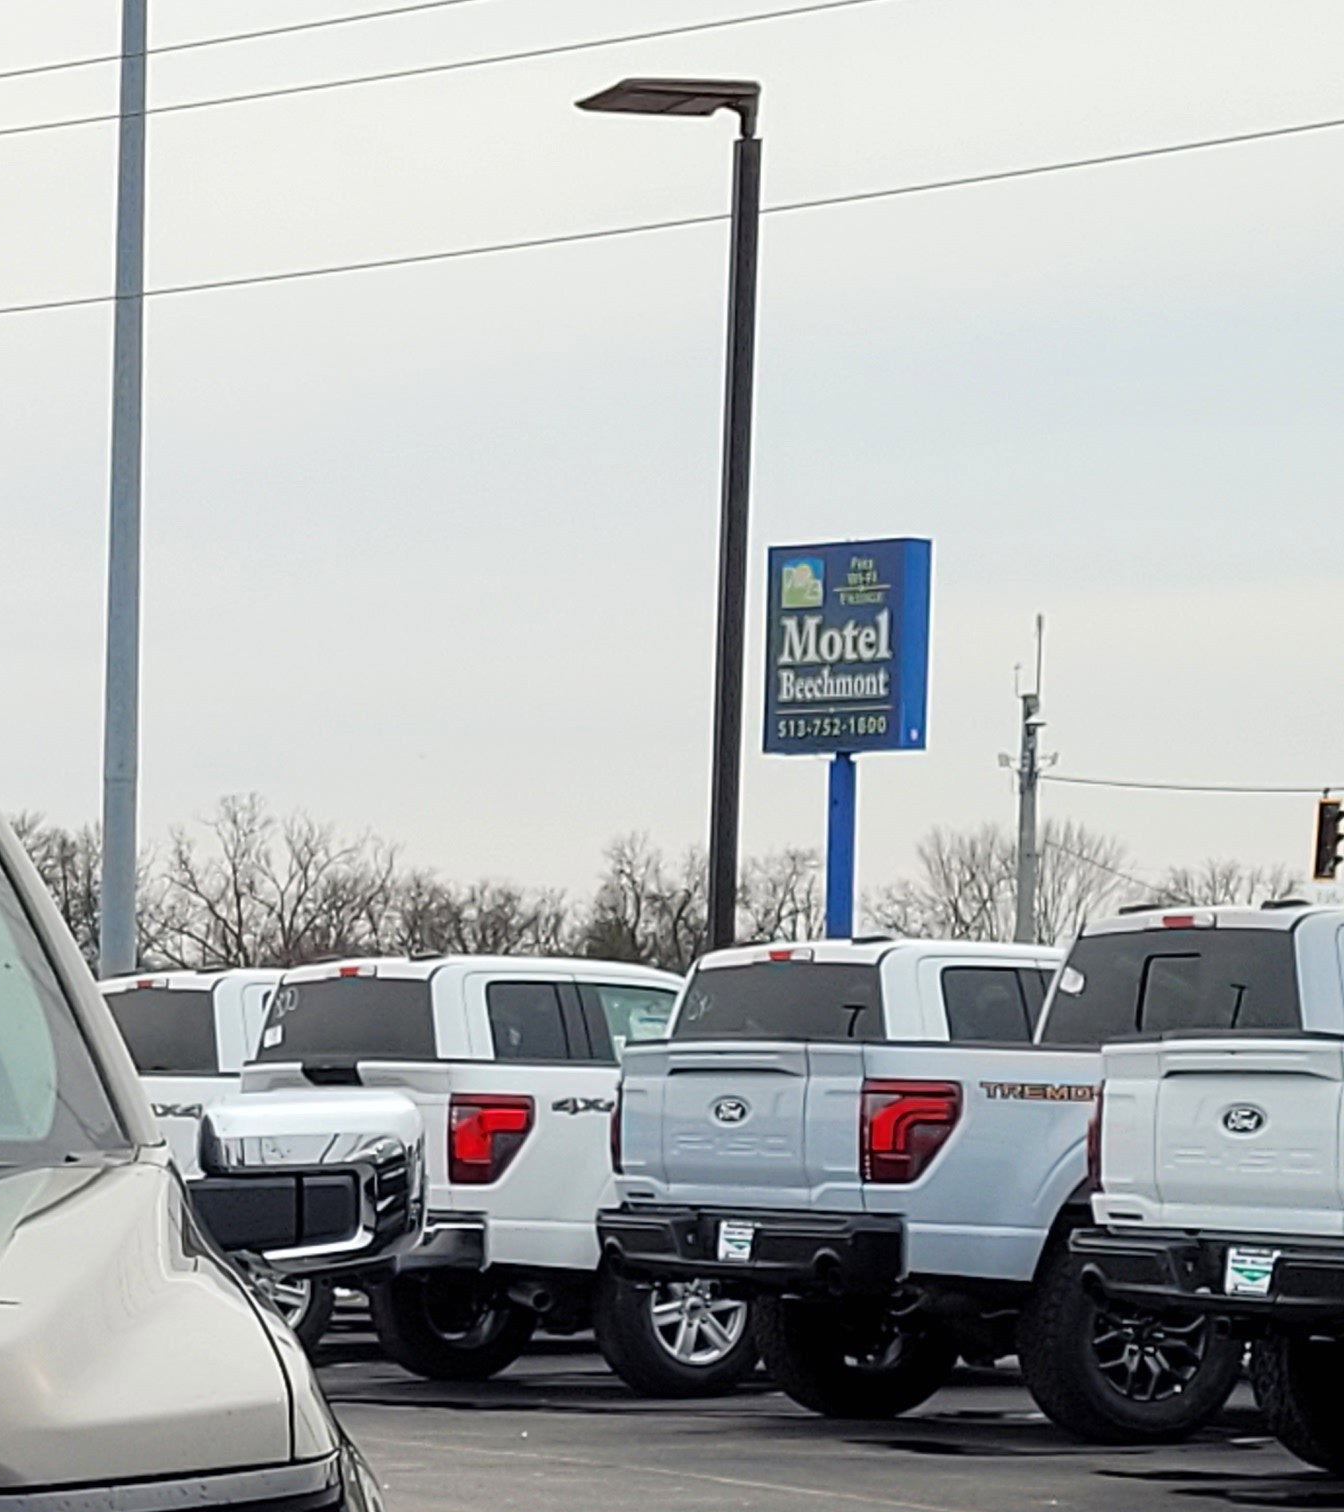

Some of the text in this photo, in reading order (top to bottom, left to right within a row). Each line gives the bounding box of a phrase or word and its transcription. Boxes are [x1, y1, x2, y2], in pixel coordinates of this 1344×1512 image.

[778, 607, 893, 664] Motel
[778, 664, 889, 701] Beechmont
[979, 1081, 1100, 1102] TREMO
[151, 1103, 202, 1120] X4
